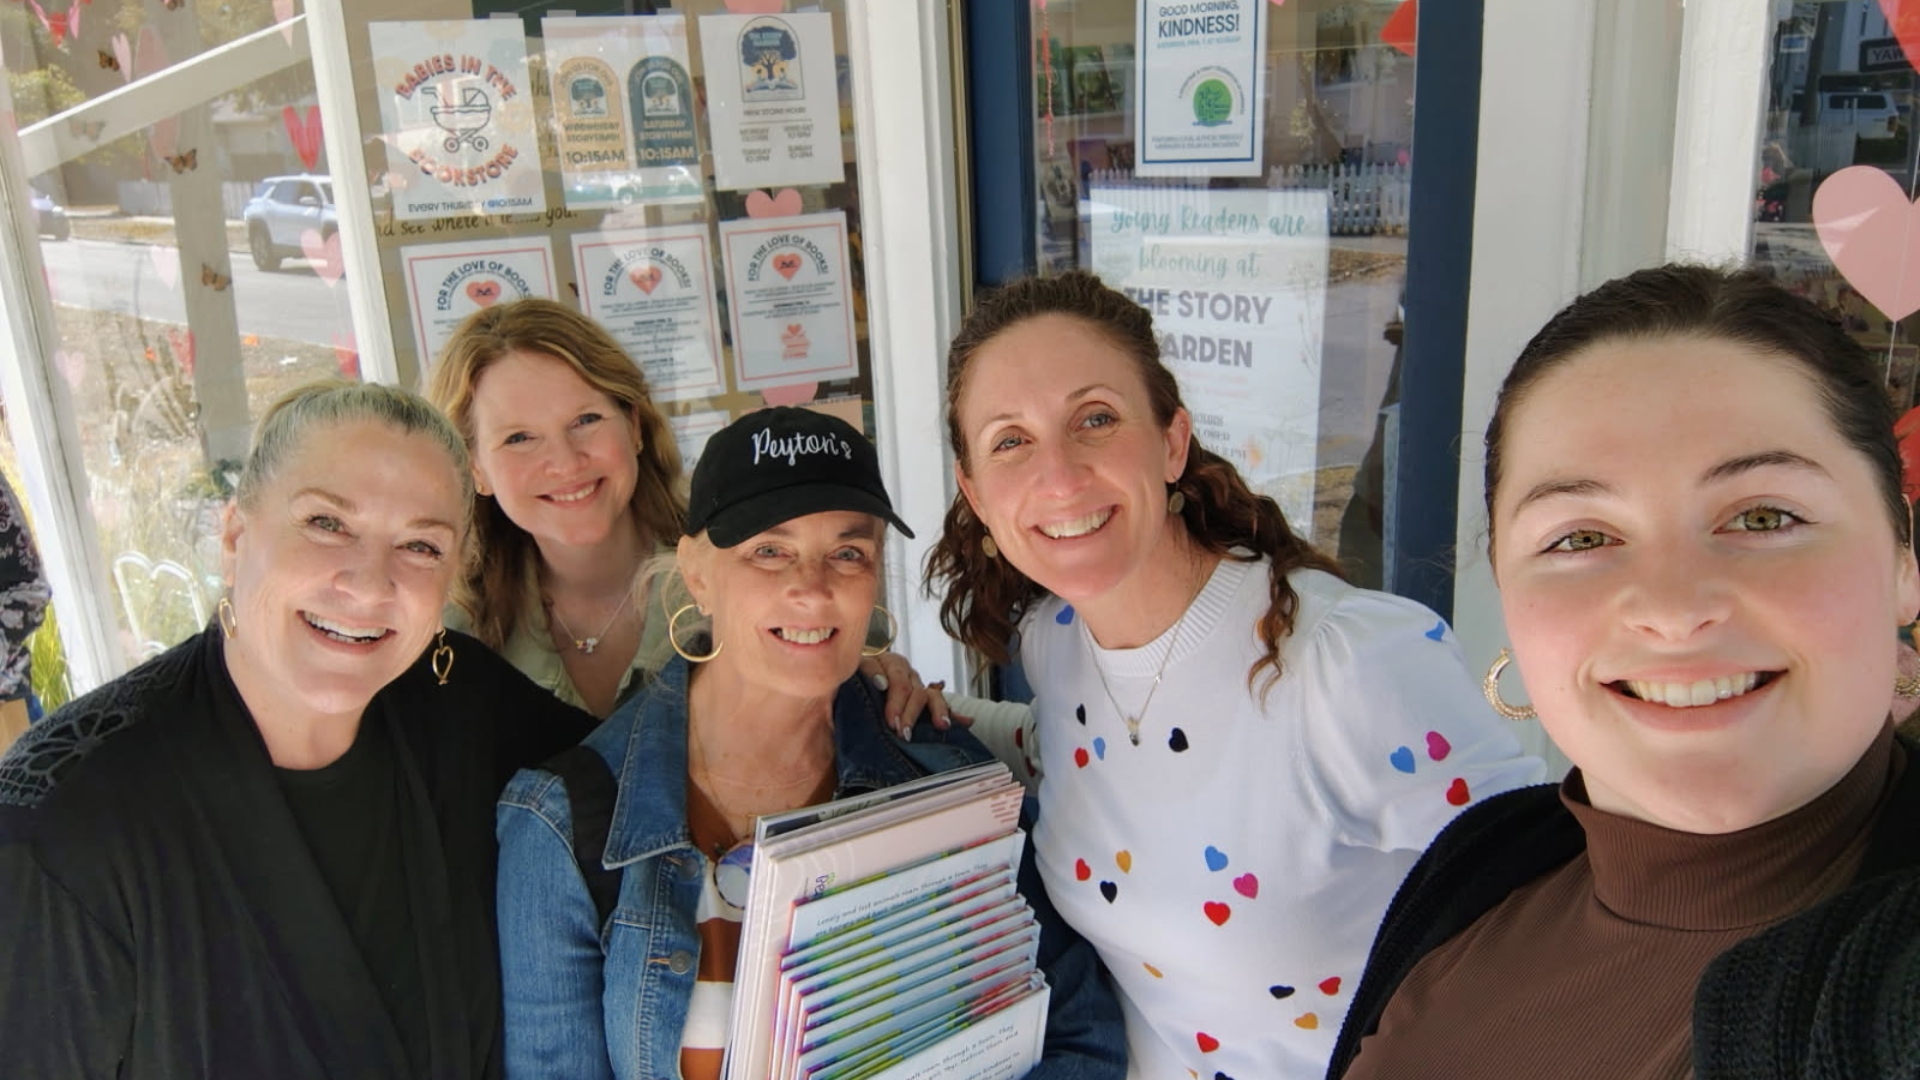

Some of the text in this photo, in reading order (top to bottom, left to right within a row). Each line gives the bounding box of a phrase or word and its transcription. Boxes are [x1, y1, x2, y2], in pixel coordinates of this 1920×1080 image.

[1159, 1, 1239, 17] GOOD MORNING,
[1158, 14, 1240, 38] KINDNESS!
[395, 54, 456, 101] BABIES
[460, 55, 482, 76] IN
[485, 64, 517, 101] THE
[409, 143, 519, 187] BOOKSTORE
[565, 149, 625, 165] 10:15AM
[639, 146, 695, 160] 10:15AM
[407, 202, 439, 213] EVERY
[1269, 213, 1306, 237] are
[458, 260, 485, 275] LOVE
[488, 261, 504, 272] OF
[748, 261, 758, 282] FOR
[753, 244, 767, 261] THE
[767, 234, 790, 248] LOVE
[792, 235, 805, 245] OF
[805, 241, 829, 274] BOOKS!
[1138, 244, 1263, 280] blooming at
[442, 270, 459, 291] THE
[604, 275, 614, 296] FOR
[624, 248, 648, 261] LOVE
[651, 247, 665, 257] OF
[665, 254, 692, 288] BOOKS!
[437, 288, 449, 311] FOR
[1178, 289, 1273, 325] STORY
[1160, 333, 1253, 368] ARDEN
[751, 426, 852, 467] Peyton's
[817, 914, 840, 926] Lonely
[842, 907, 857, 917] and
[859, 902, 871, 912] lost
